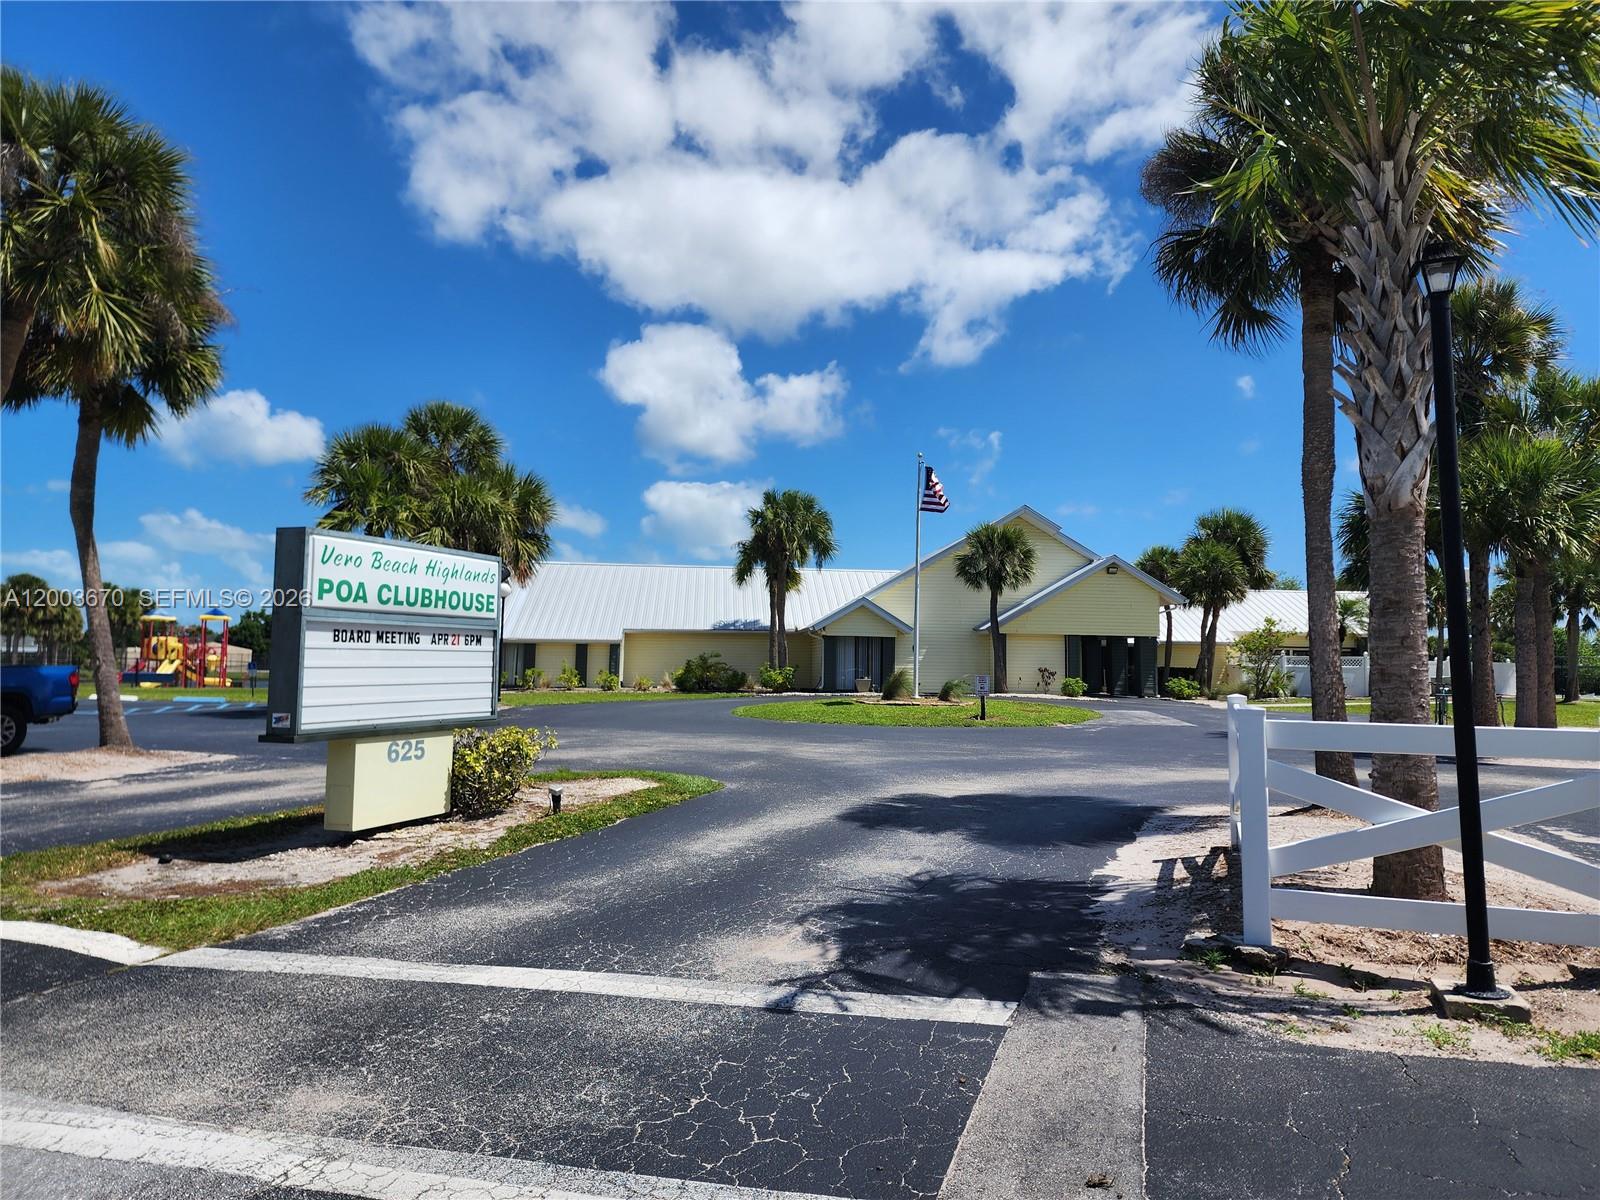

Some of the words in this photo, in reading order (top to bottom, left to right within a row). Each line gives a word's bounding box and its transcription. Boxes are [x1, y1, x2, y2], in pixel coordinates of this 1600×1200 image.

[320, 544, 362, 567] Vero
[371, 551, 418, 575] Beach
[425, 559, 497, 584] Highlands
[318, 578, 368, 604] POA
[377, 584, 495, 613] CLUBHOUSE
[333, 629, 371, 644] BOARD
[376, 631, 421, 645] MEETING
[431, 633, 449, 646] APR
[451, 633, 461, 646] 21
[464, 634, 482, 646] 6PM
[387, 739, 425, 763] 625
